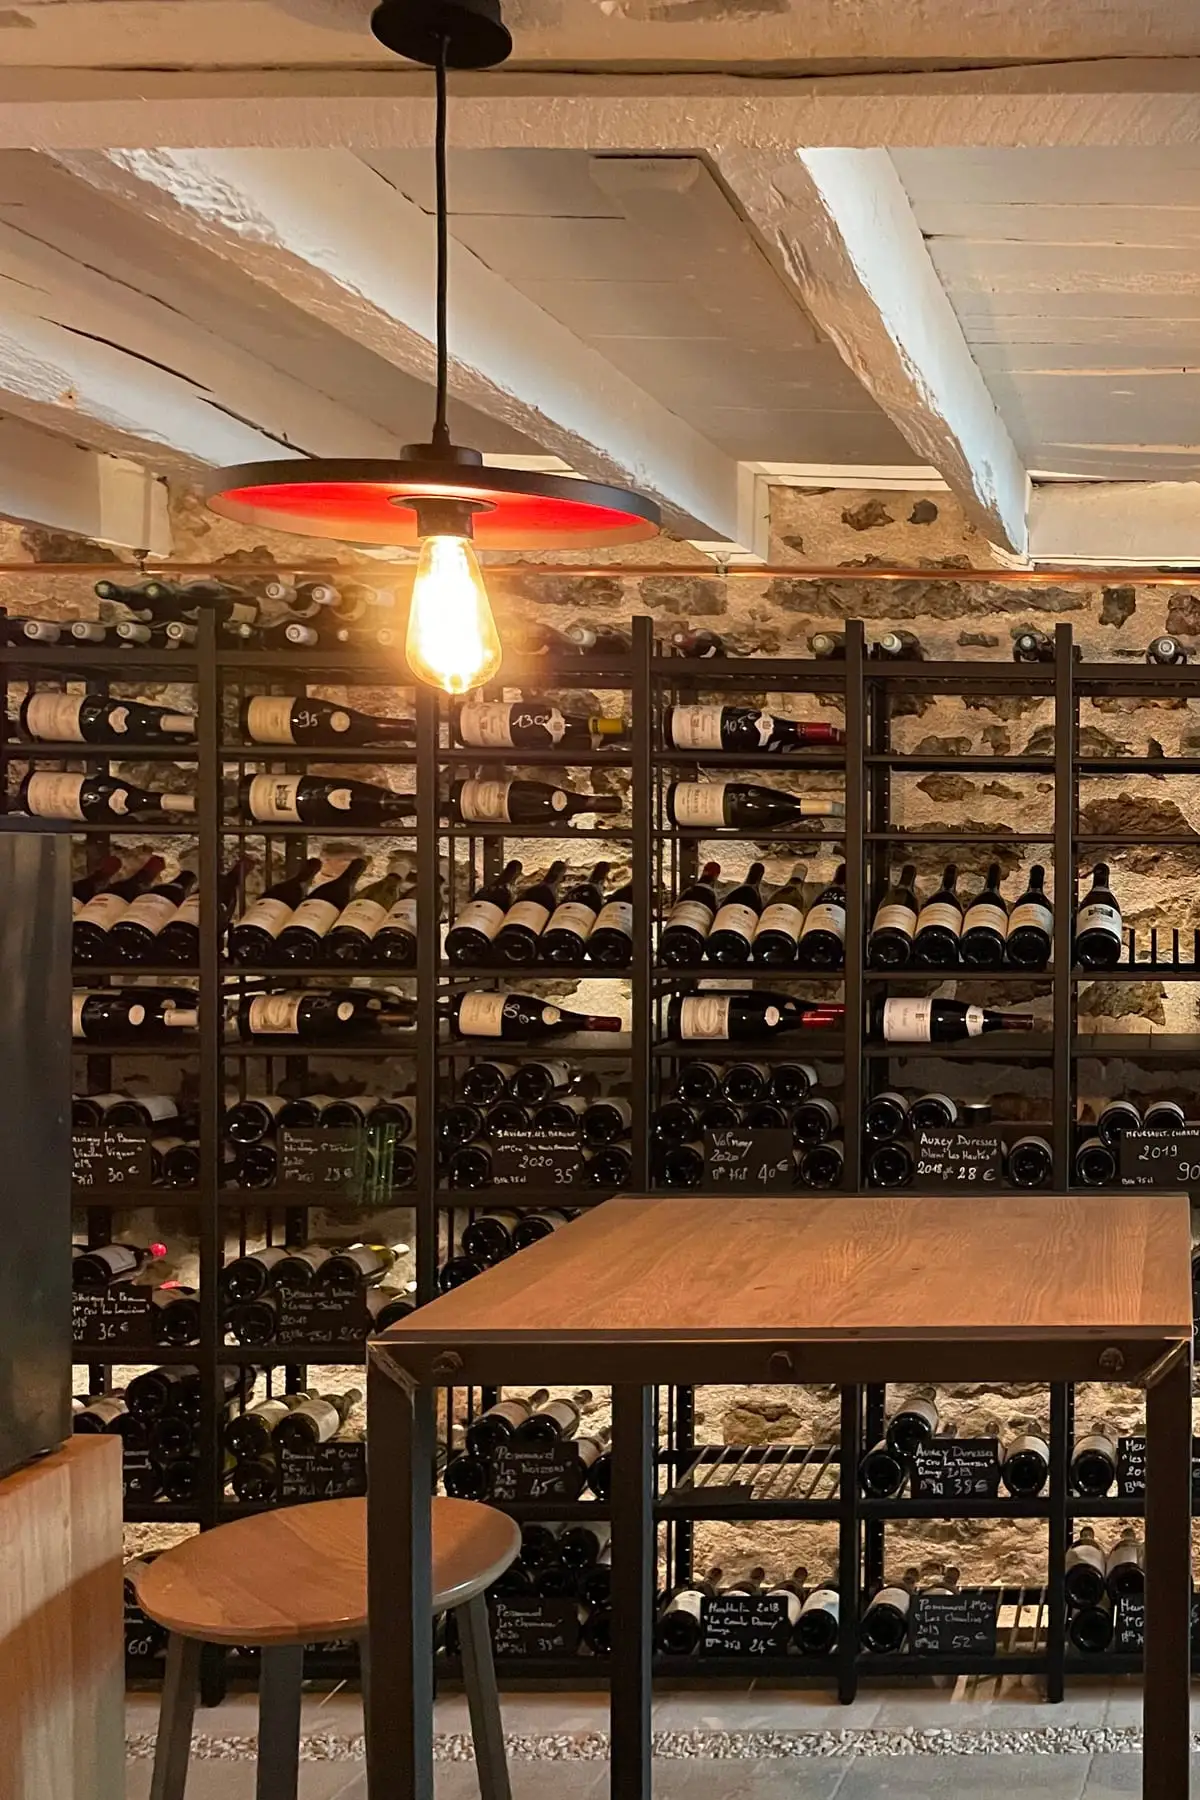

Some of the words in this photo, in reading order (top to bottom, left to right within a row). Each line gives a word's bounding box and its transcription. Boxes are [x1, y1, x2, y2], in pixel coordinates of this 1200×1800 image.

[920, 1132, 954, 1152] Auxey
[1138, 1145, 1178, 1160] 2019
[518, 1155, 554, 1169] 2020
